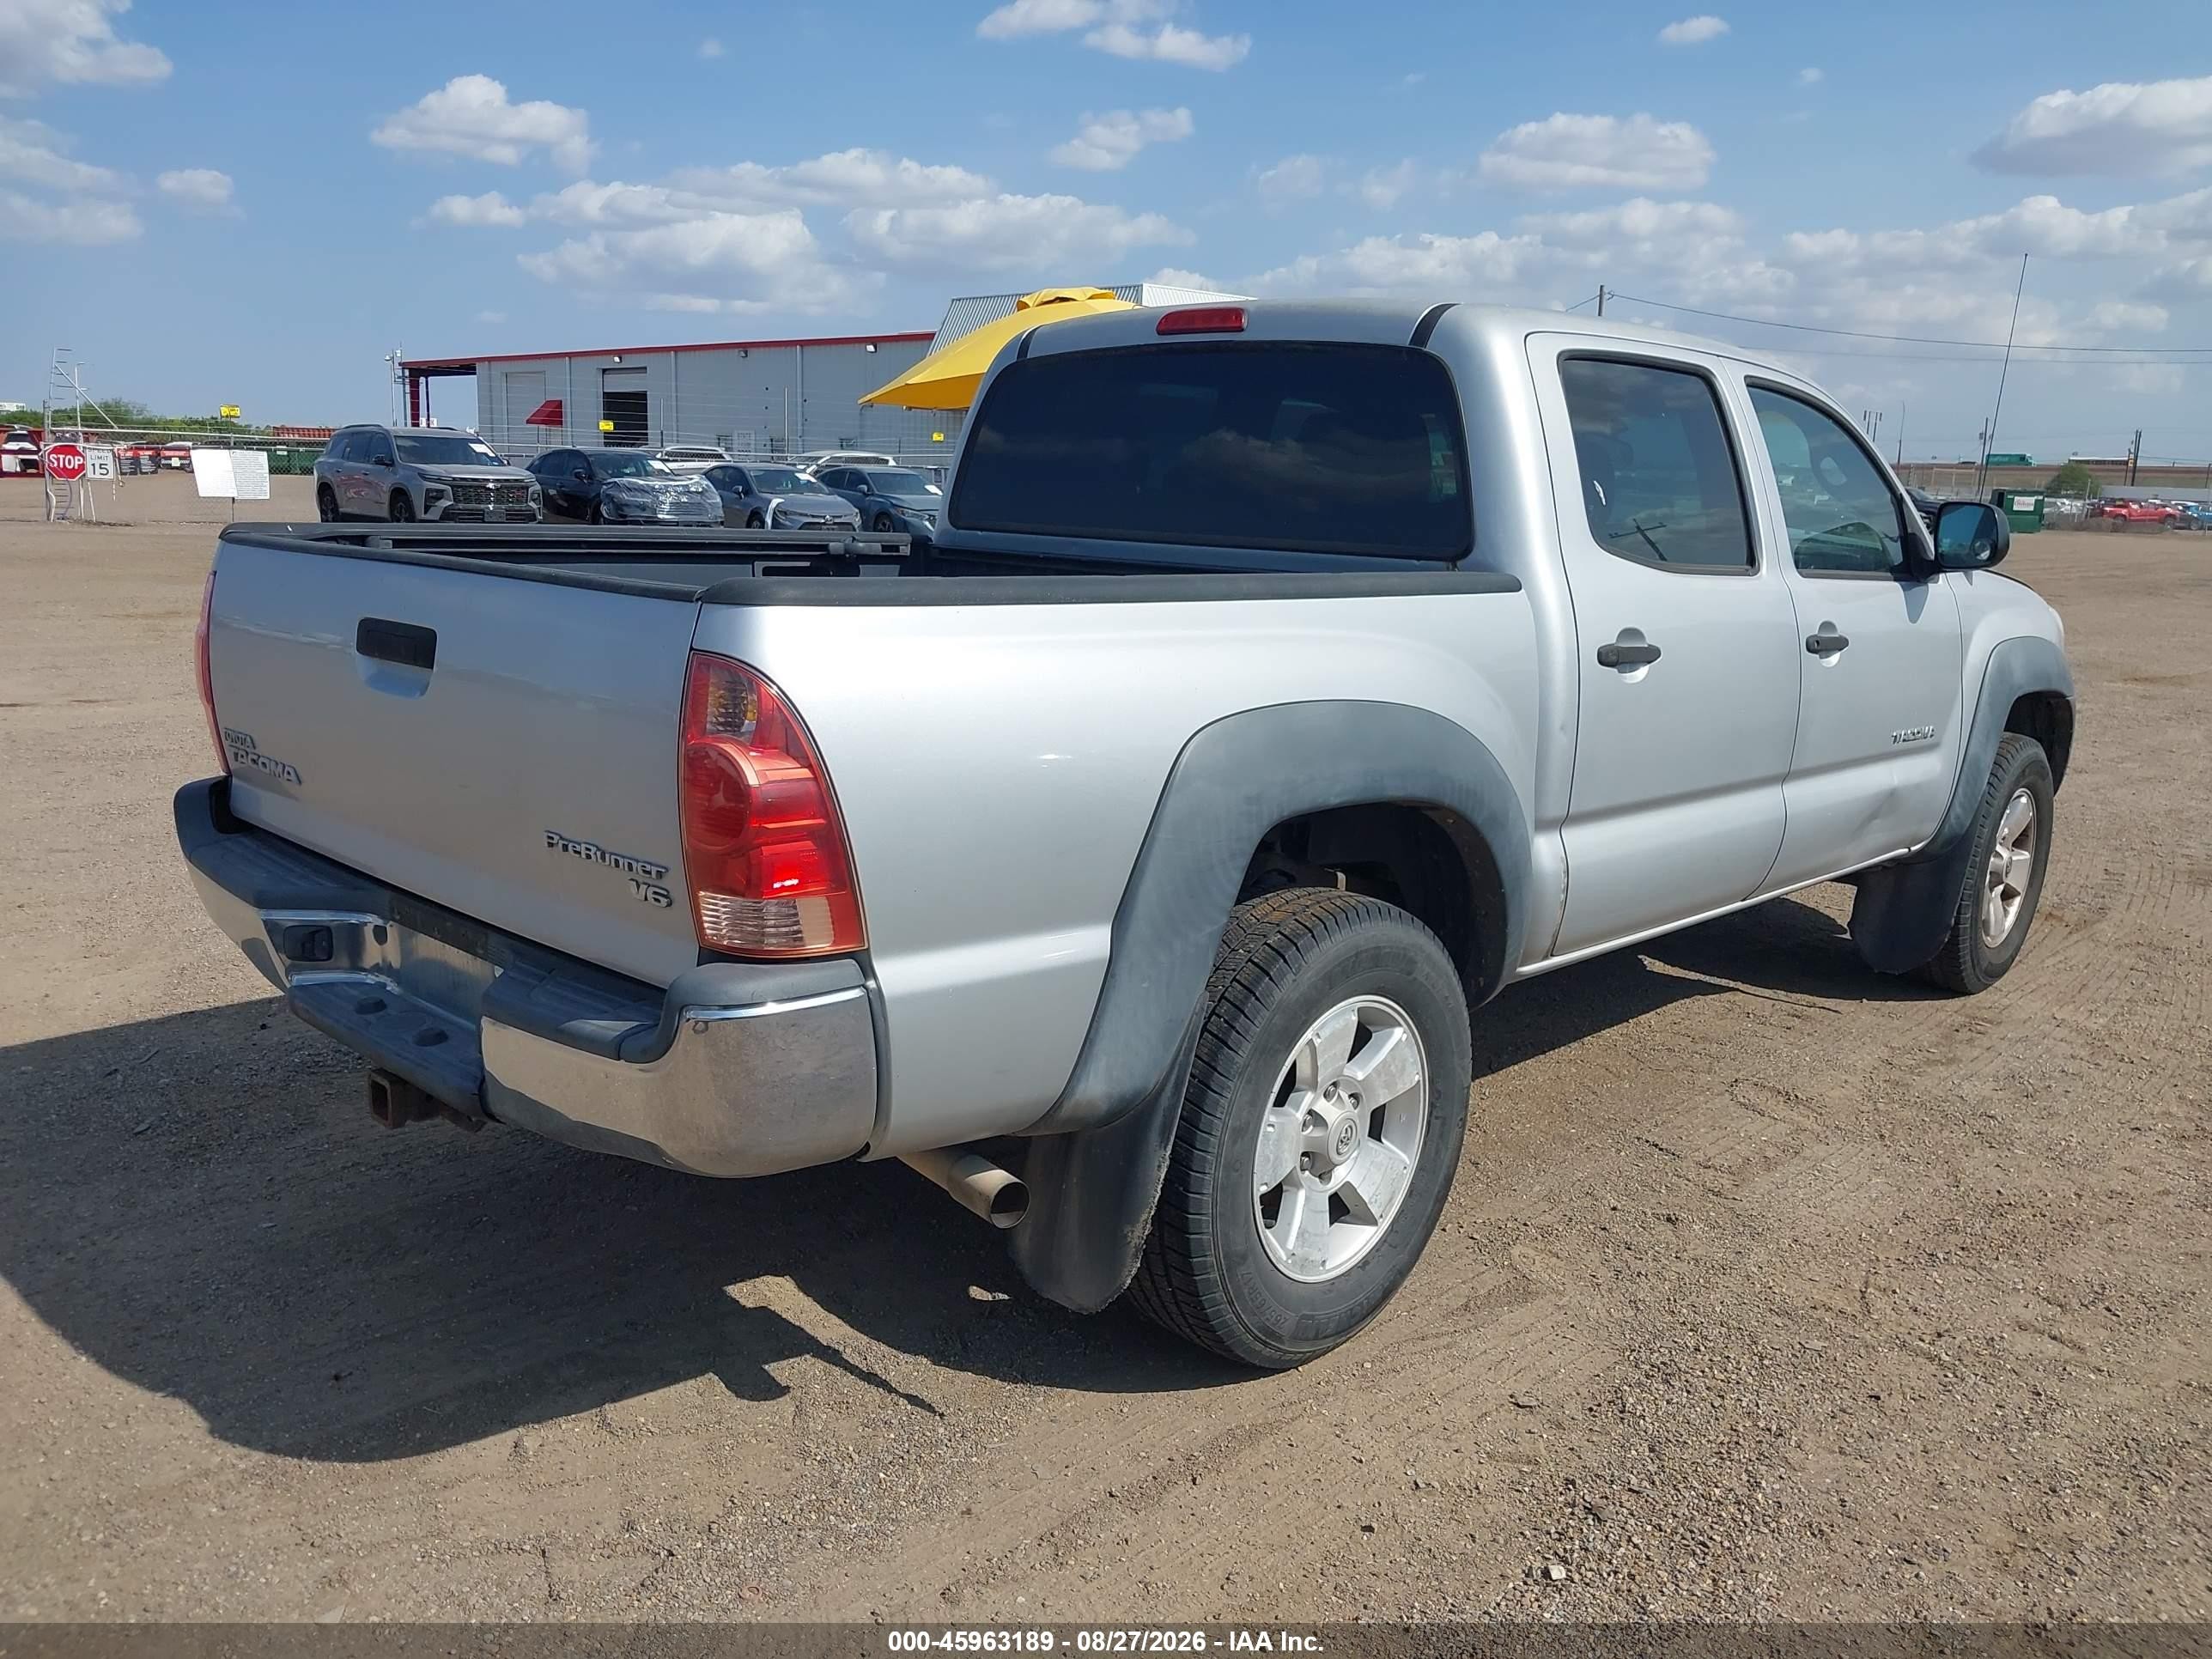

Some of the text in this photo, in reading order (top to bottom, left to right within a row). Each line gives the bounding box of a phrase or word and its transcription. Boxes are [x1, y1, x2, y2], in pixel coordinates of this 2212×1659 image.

[49, 453, 84, 470] STOP
[90, 463, 110, 476] 15
[229, 744, 301, 785] TACOMA
[544, 830, 670, 880] PreRunner
[628, 878, 673, 908] V6
